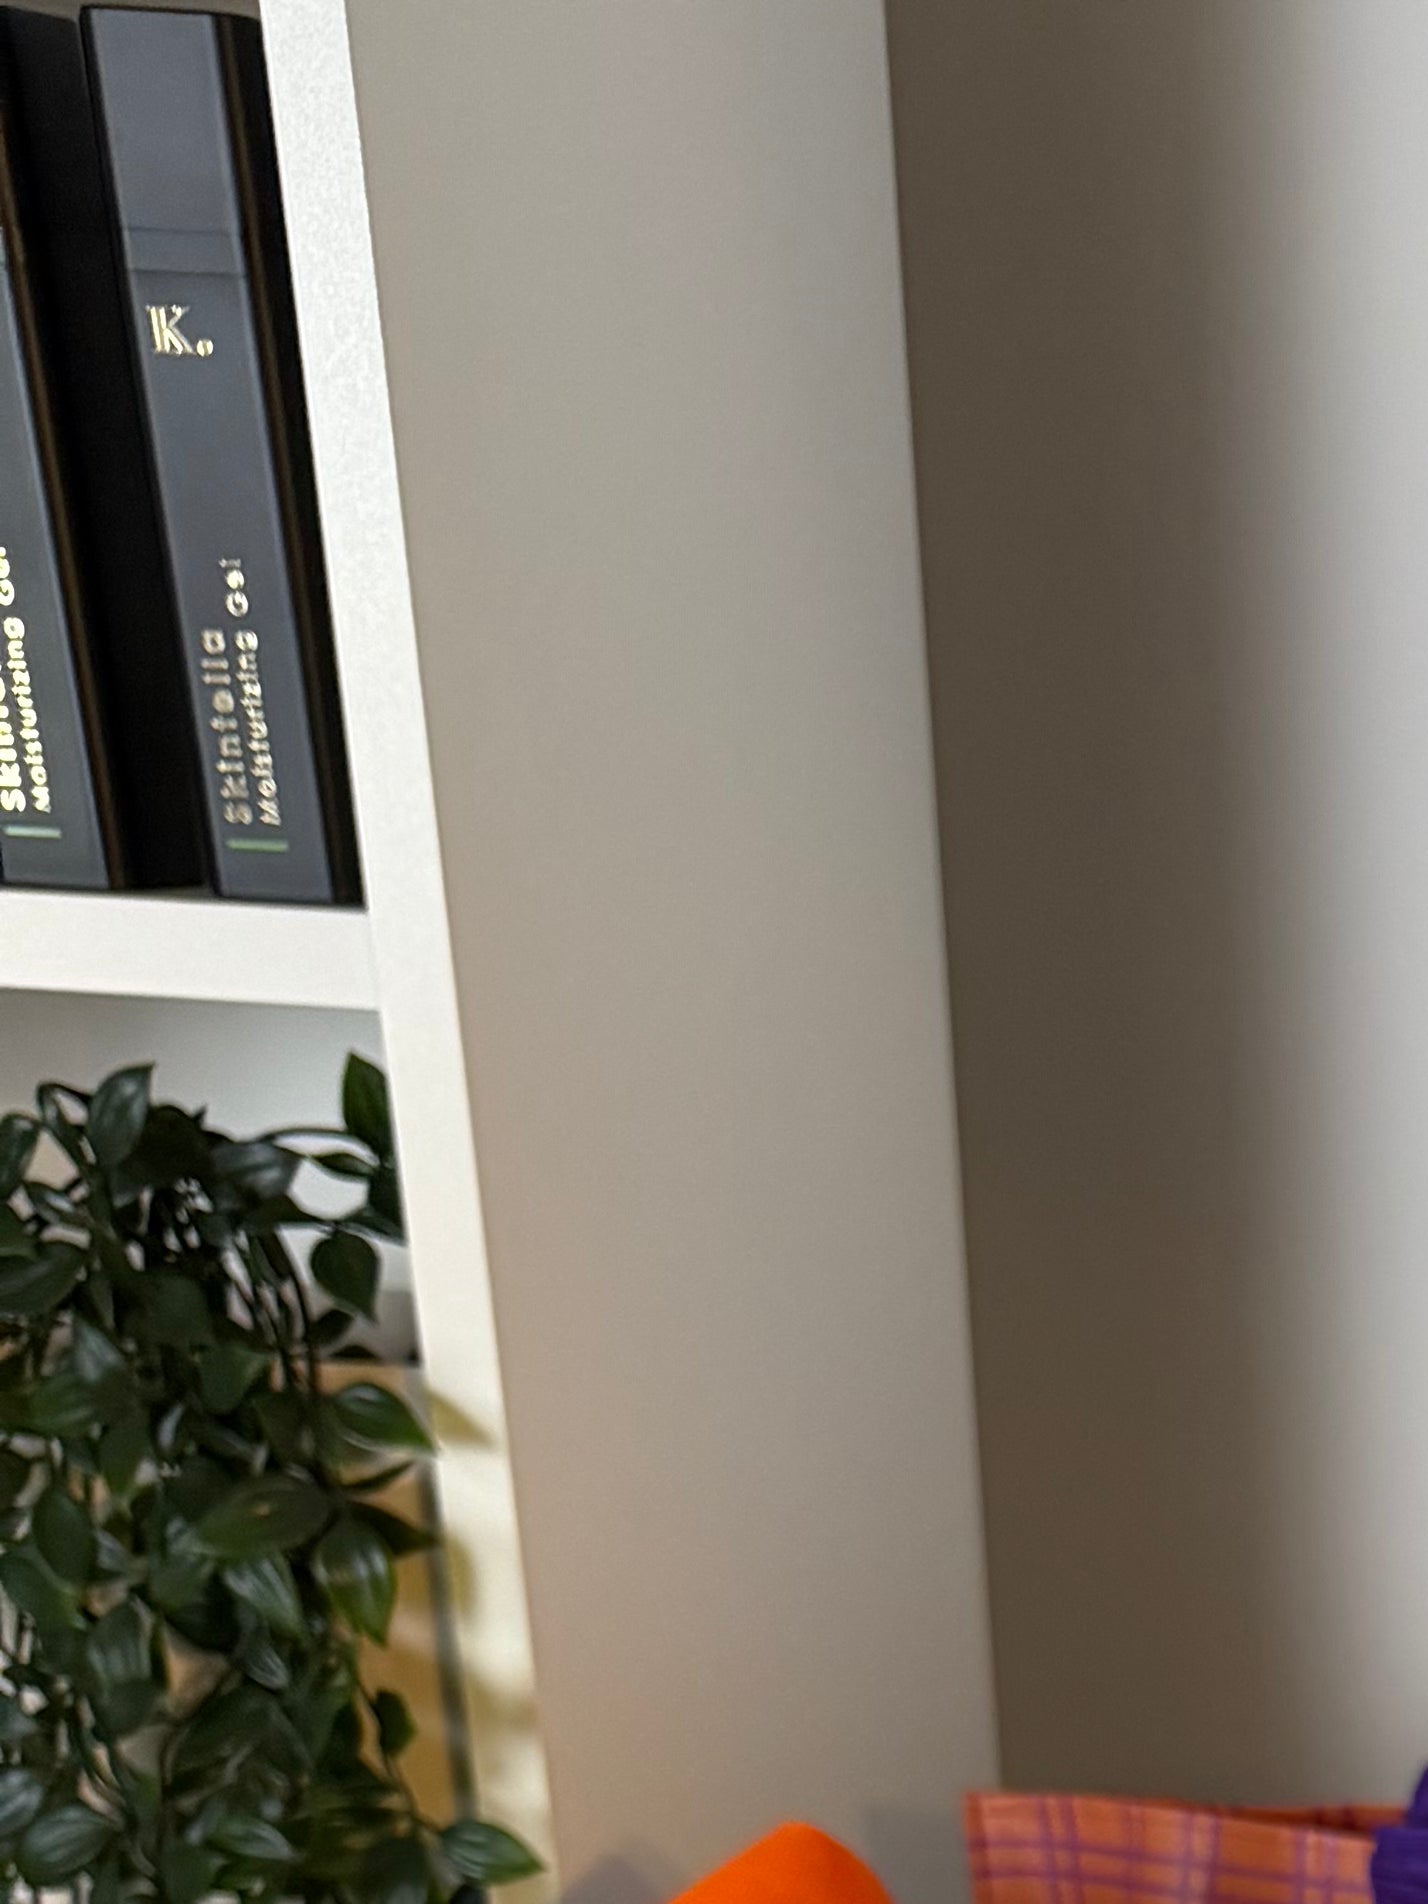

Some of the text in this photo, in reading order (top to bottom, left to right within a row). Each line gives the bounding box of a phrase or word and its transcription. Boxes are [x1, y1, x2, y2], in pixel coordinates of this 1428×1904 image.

[144, 304, 215, 358] K.
[3, 616, 51, 814] Moisturizing
[218, 557, 282, 826] Moisturizing Gel
